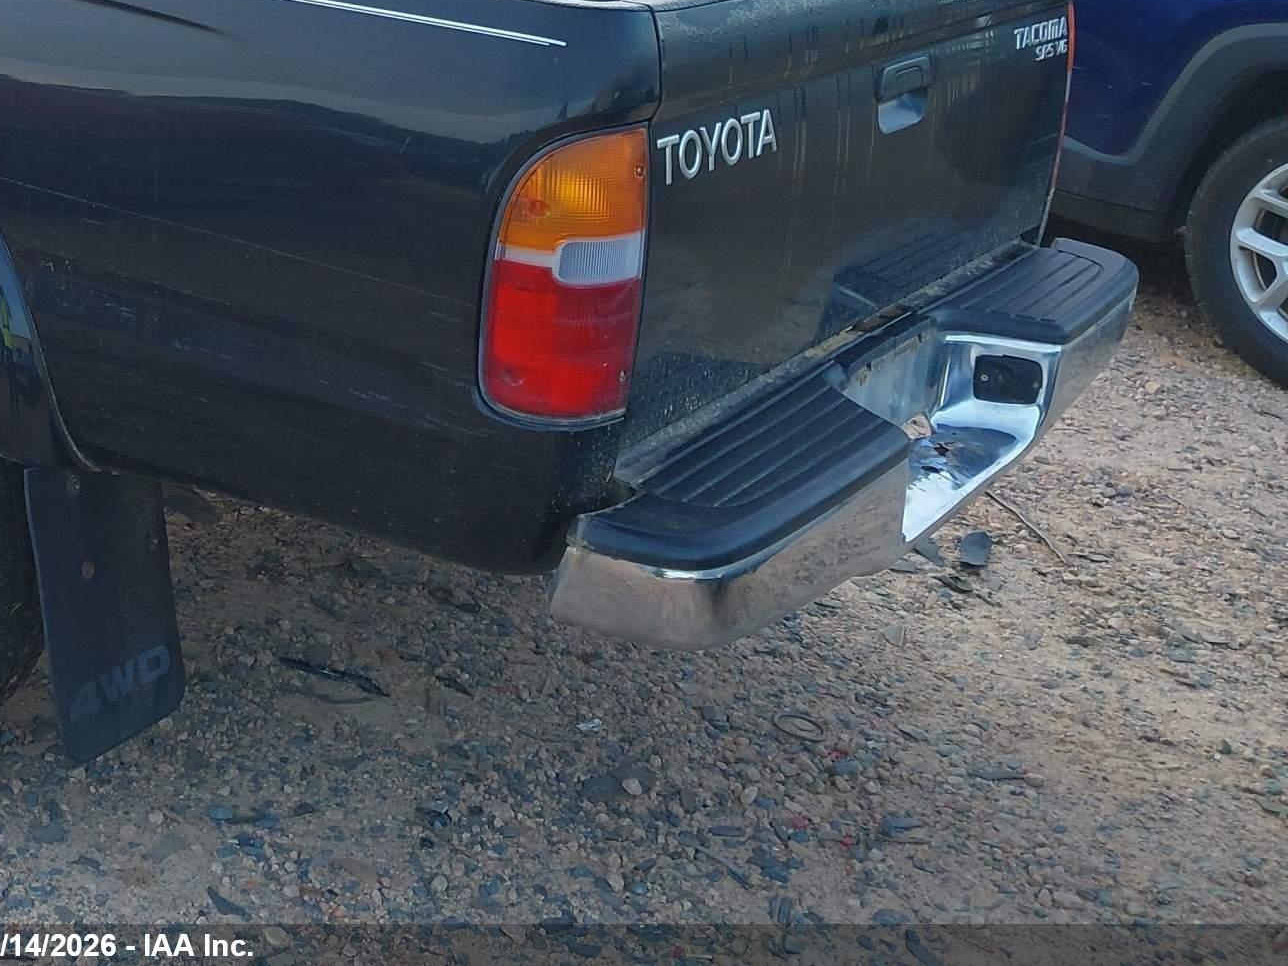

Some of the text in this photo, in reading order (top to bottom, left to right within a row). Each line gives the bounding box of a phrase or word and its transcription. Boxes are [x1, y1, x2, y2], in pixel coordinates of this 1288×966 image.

[1014, 16, 1067, 50] TACOMA
[656, 109, 778, 186] TOYOTA
[70, 645, 170, 723] 4WD
